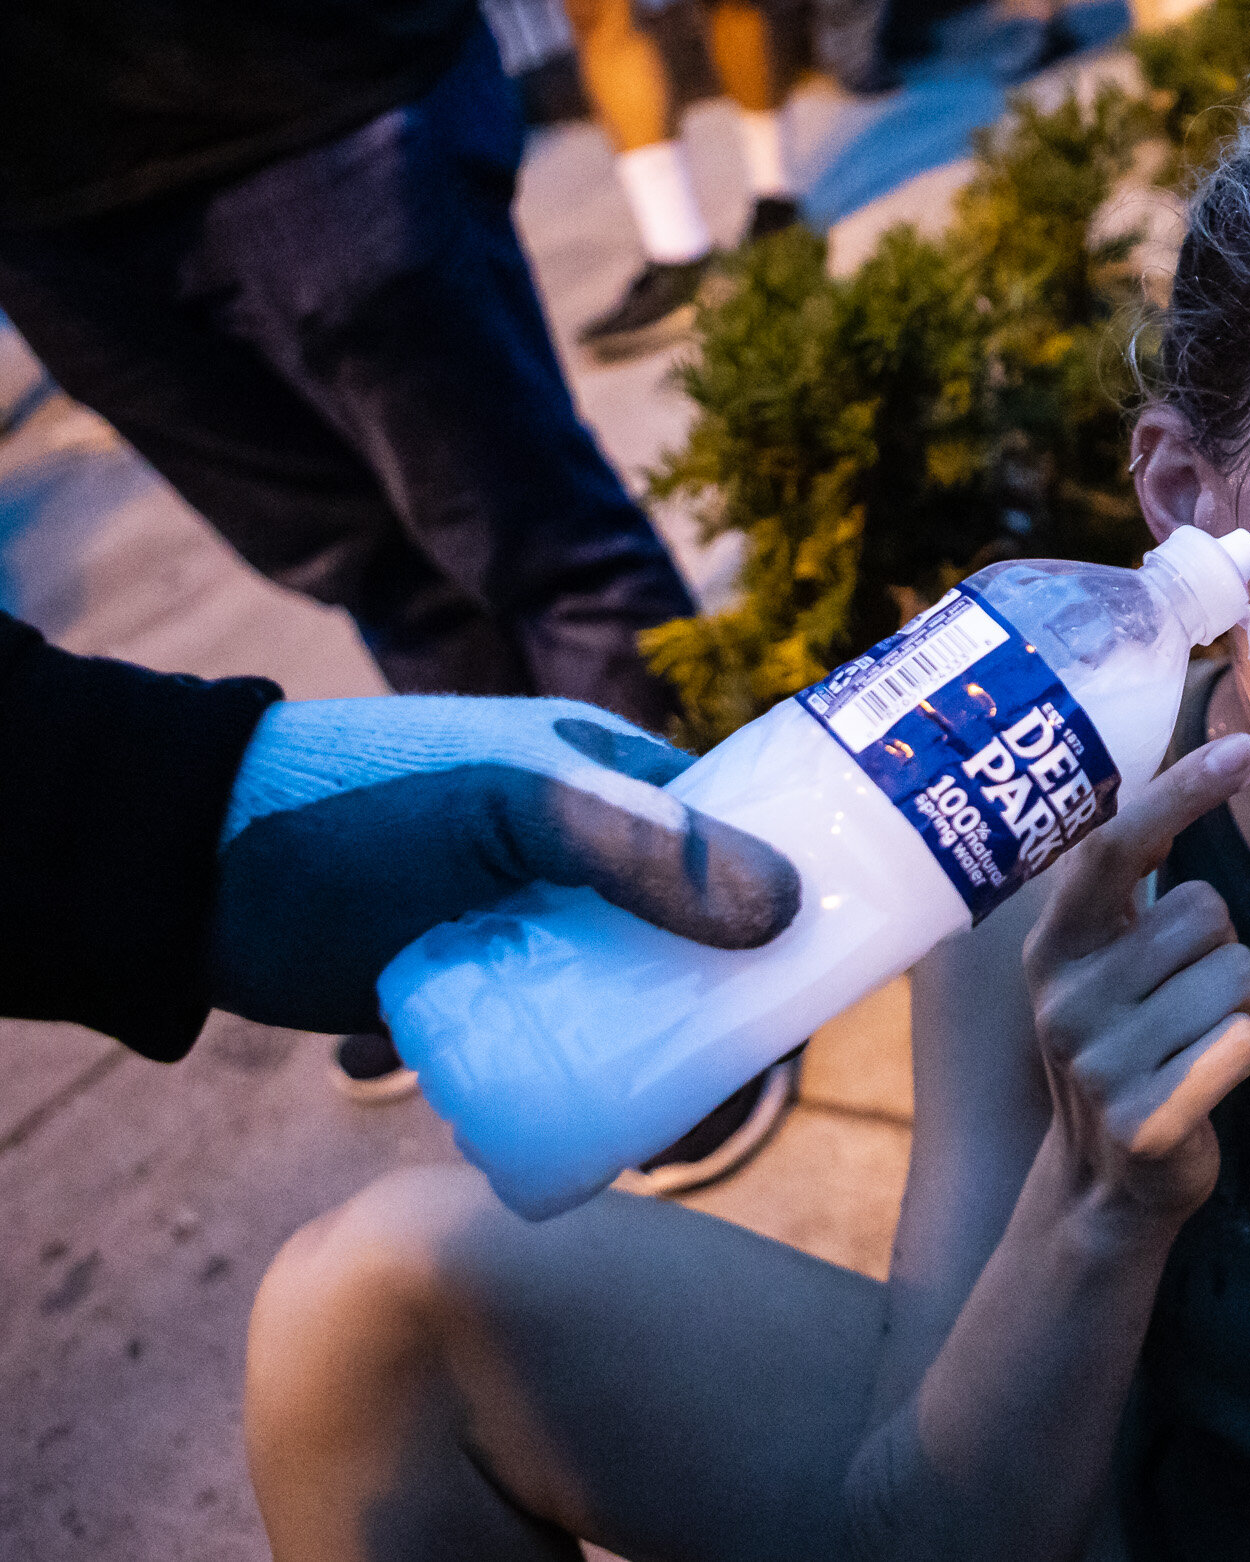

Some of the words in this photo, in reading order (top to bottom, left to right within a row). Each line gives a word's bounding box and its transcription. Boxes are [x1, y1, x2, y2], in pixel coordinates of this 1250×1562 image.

[1000, 706, 1097, 839] DEER
[1040, 702, 1065, 730] EST.
[914, 793, 959, 848] spring
[952, 842, 987, 888] water
[926, 774, 992, 842] 100%
[964, 831, 1007, 888] natural
[961, 736, 1066, 870] PARK
